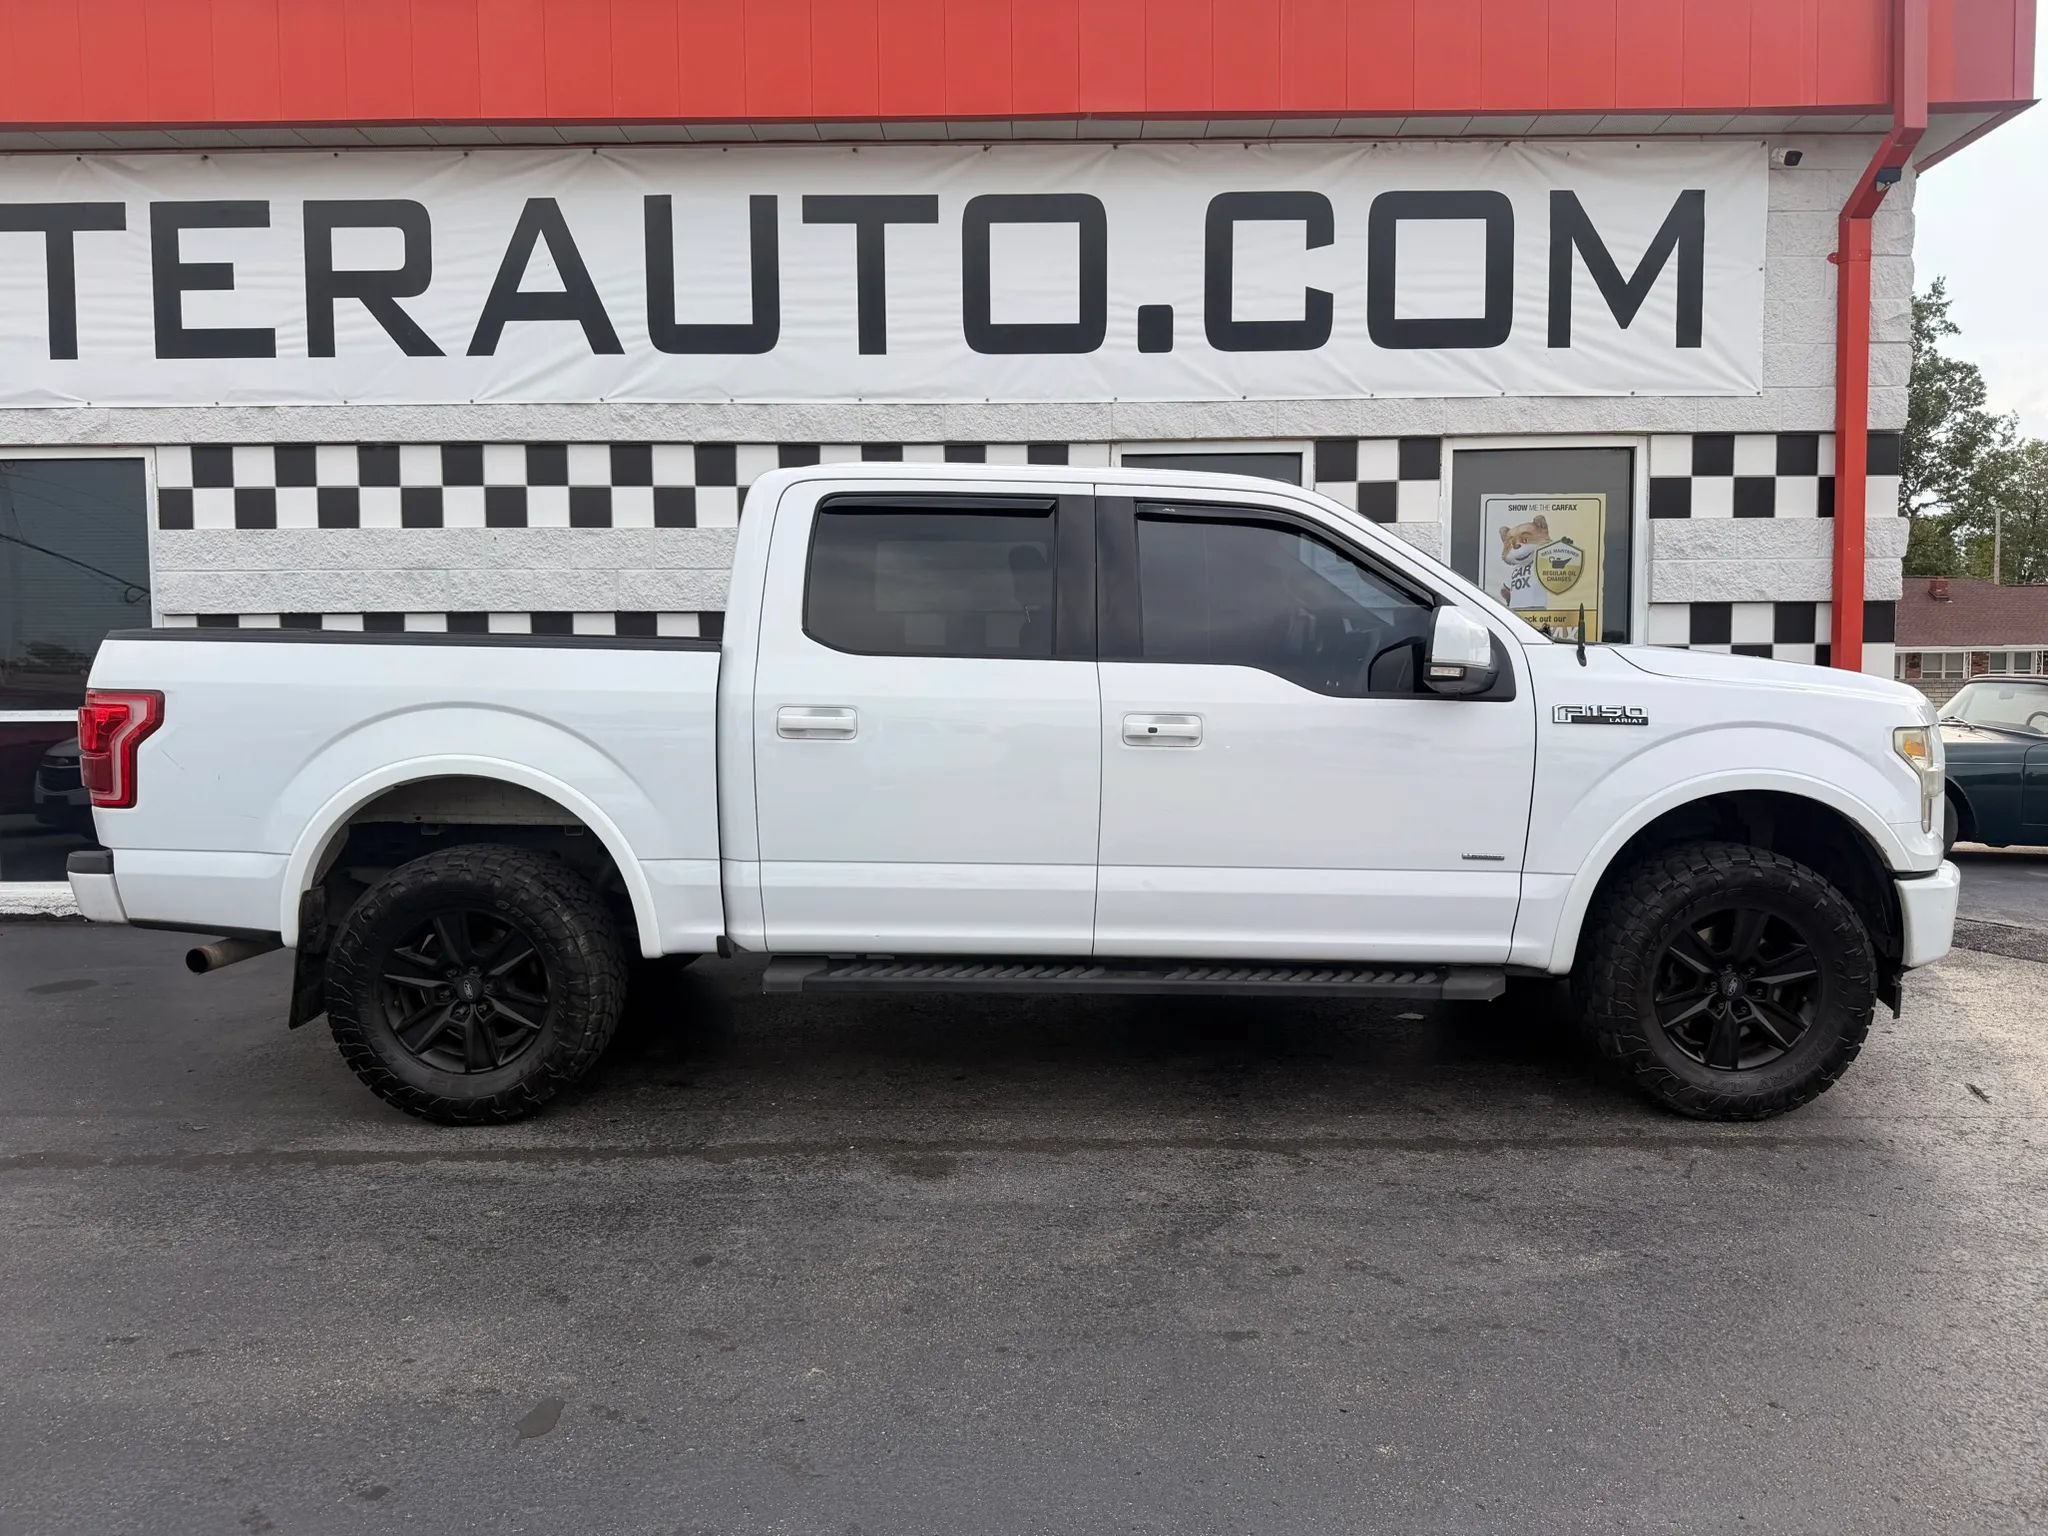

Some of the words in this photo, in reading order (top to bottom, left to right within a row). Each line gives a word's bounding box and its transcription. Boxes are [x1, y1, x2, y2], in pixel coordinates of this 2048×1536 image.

[0, 190, 1706, 361] TERAUTO.COM
[1551, 503, 1578, 511] CARFAX
[1511, 564, 1532, 580] CAR
[1511, 576, 1532, 591] FOX
